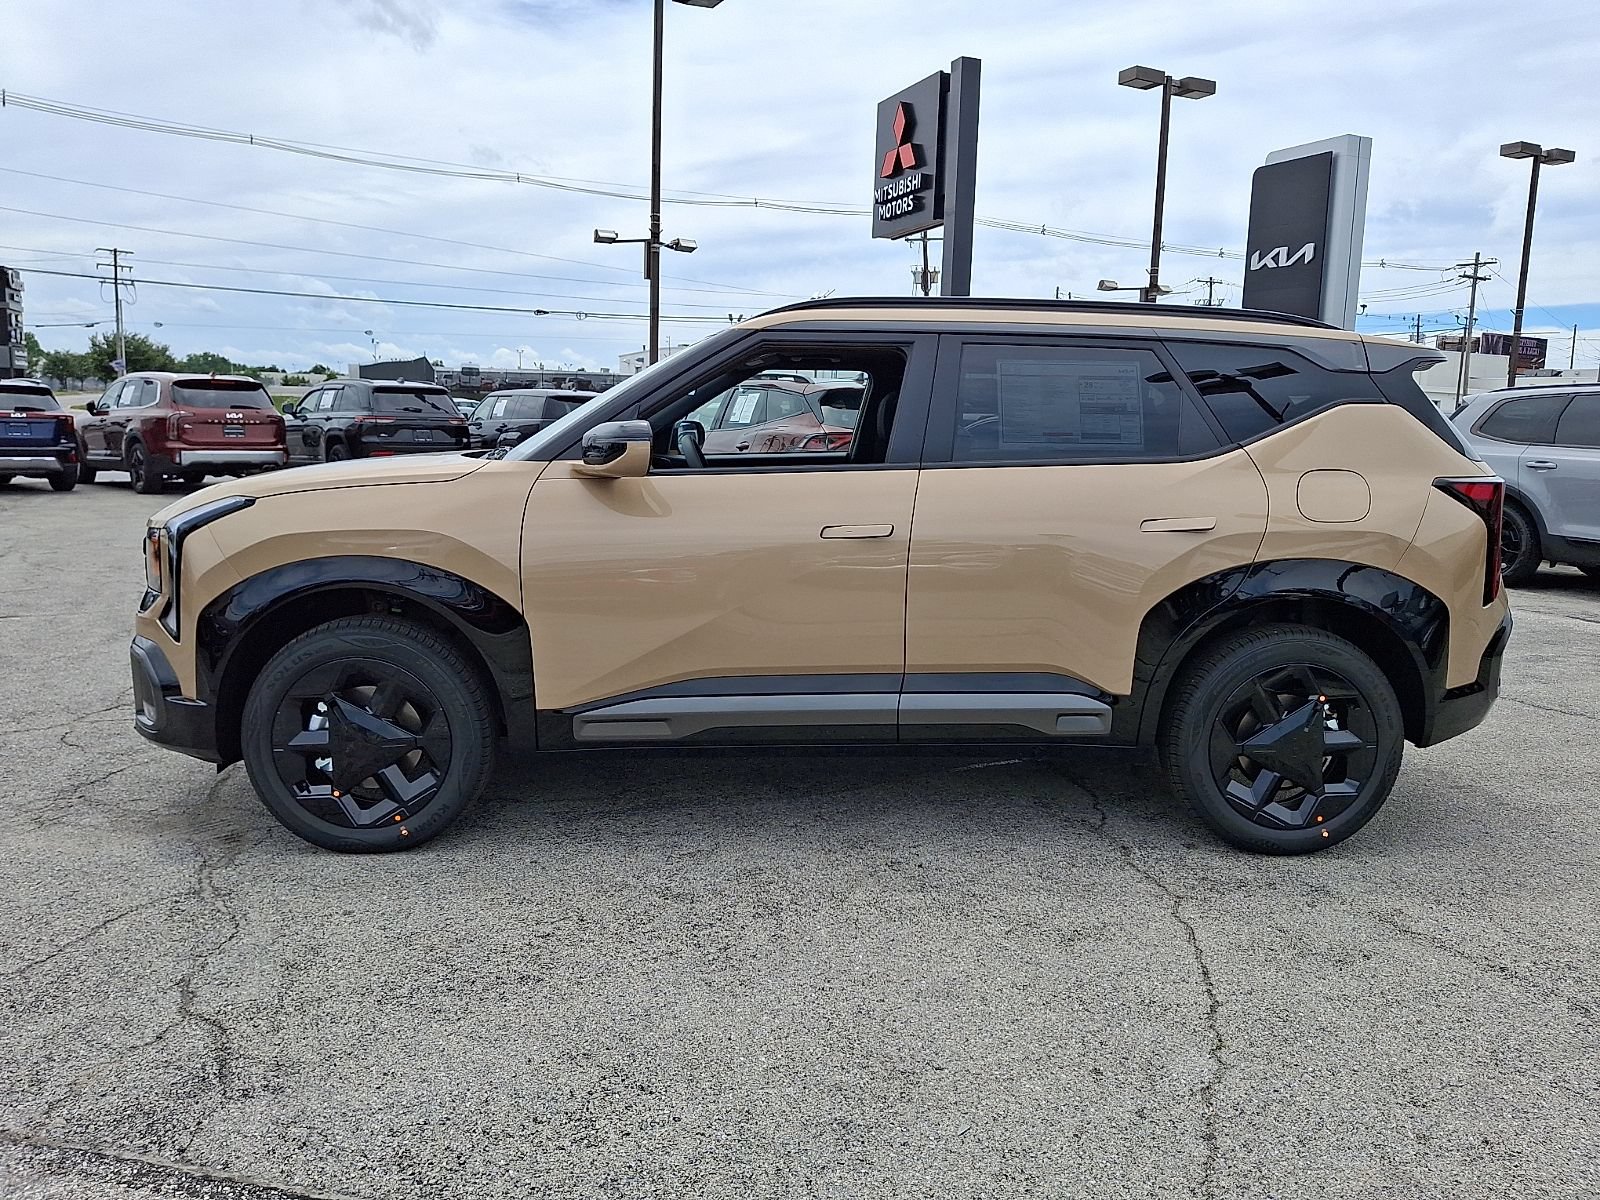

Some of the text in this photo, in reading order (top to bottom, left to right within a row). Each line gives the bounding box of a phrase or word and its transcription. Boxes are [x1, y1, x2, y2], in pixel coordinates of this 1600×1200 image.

[875, 173, 921, 202] MITSUBISHI
[879, 195, 914, 220] MOTORS
[1251, 243, 1315, 270] KIA
